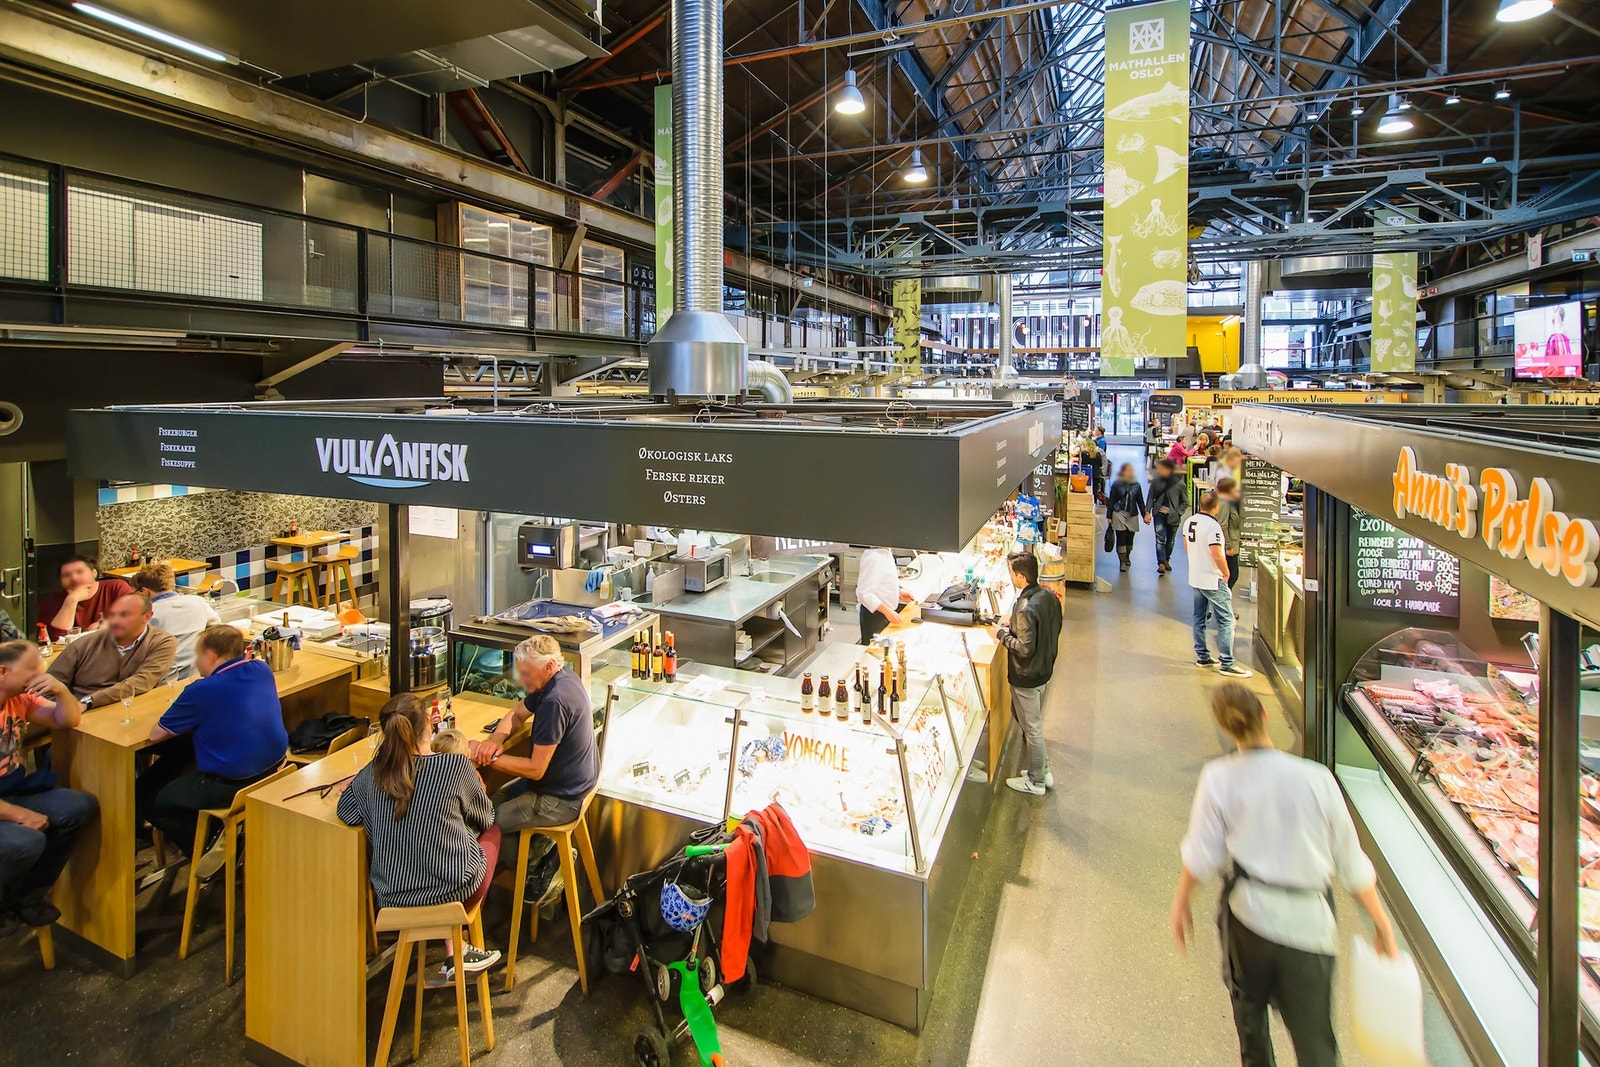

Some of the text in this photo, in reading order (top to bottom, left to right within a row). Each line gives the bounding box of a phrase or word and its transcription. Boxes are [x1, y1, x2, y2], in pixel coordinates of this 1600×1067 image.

[1109, 53, 1186, 71] MATHALLEN
[1129, 67, 1164, 80] OSLO
[158, 427, 198, 437] FISKEBURGER
[160, 442, 197, 453] FISKEKAKER
[315, 433, 470, 482] VULKANFISK
[638, 447, 733, 463] ØKOLOGISK LAKS
[161, 457, 196, 469] FISKESUPPE
[645, 468, 725, 485] FERSKE REKER
[663, 491, 706, 505] ØSTERS
[1188, 521, 1198, 543] 5
[1215, 533, 1221, 542] 5
[1358, 537, 1394, 548] REINDEER
[1357, 548, 1384, 558] MOOSE
[1397, 549, 1422, 559] SALAMI
[1380, 559, 1410, 571] REINDEER
[1412, 560, 1436, 572] HEART
[1382, 568, 1420, 580] REINDEER
[1383, 580, 1402, 590] HAM
[1373, 598, 1392, 607] LOCAL
[1404, 600, 1441, 613] HANDMADE
[784, 731, 850, 772] VONGOLE
